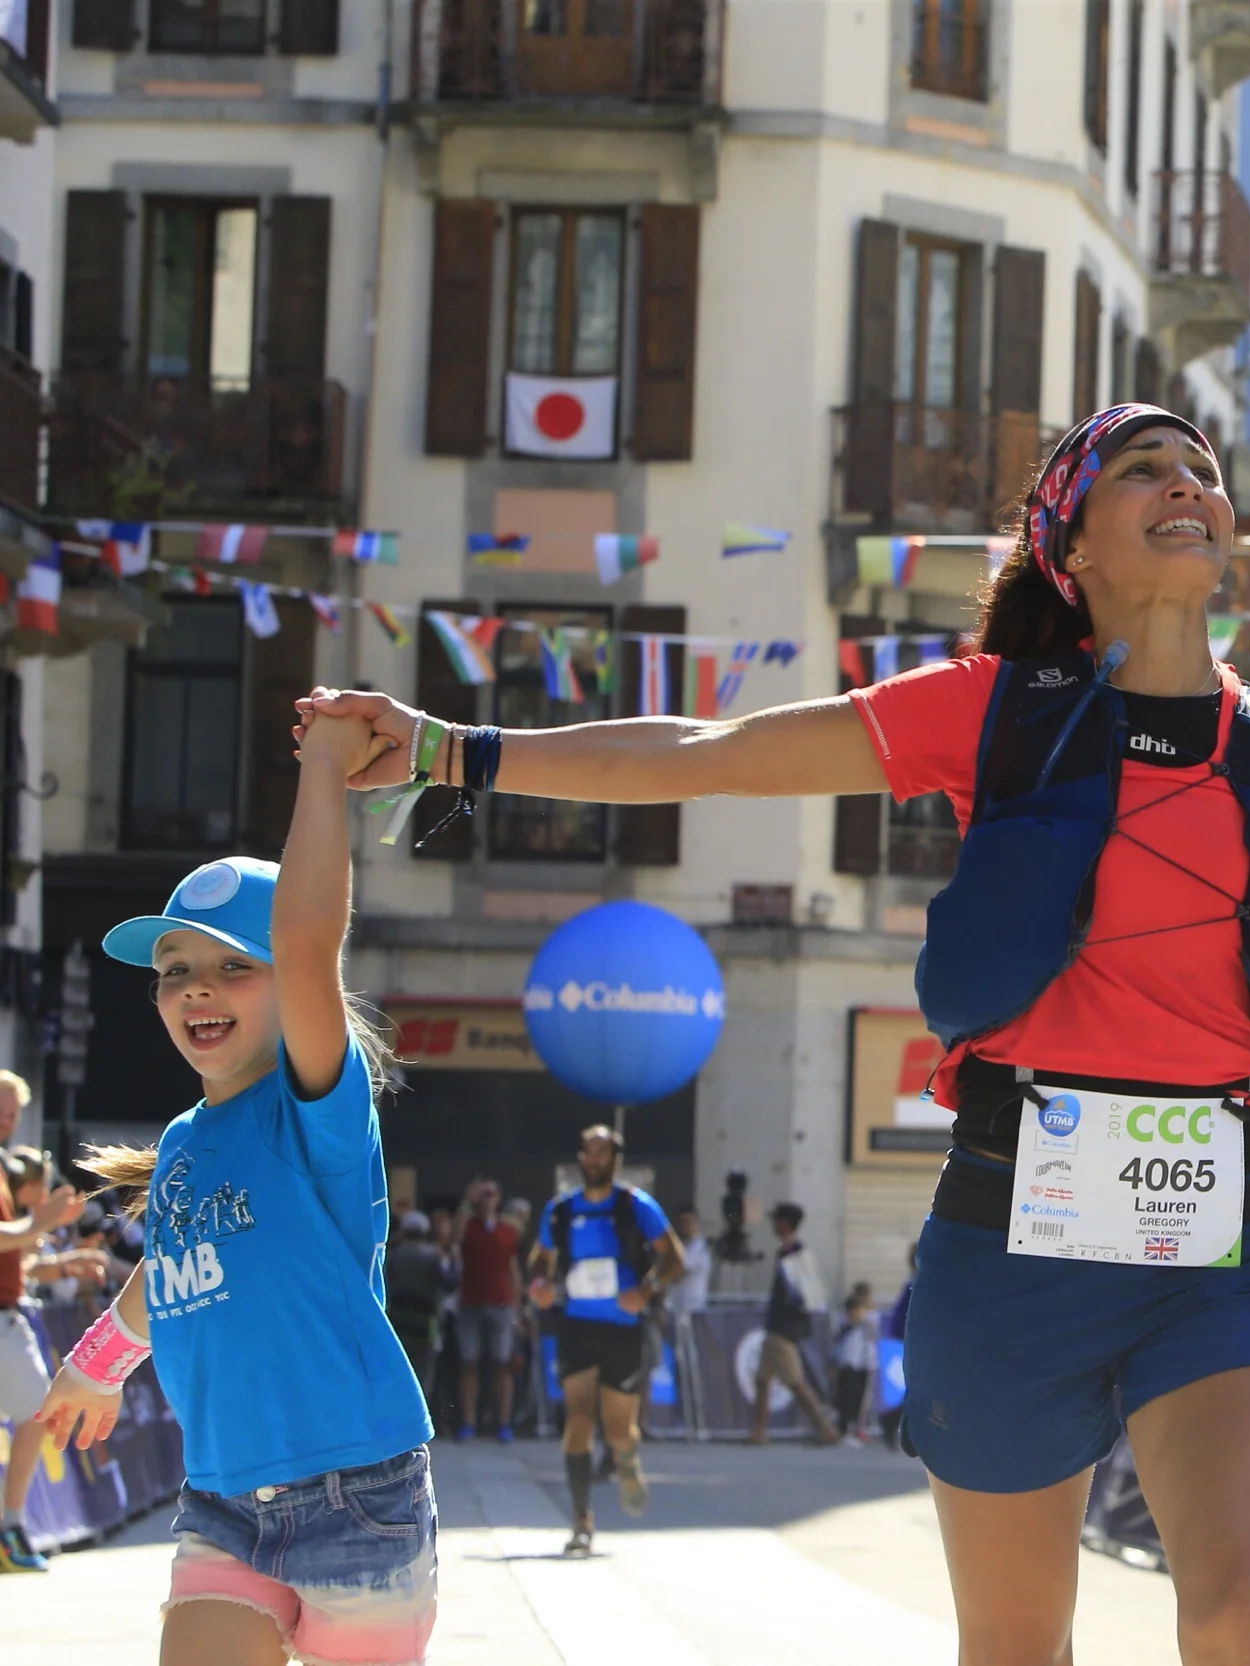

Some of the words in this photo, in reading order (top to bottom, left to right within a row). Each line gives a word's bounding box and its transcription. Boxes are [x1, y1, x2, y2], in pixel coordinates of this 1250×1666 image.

[1129, 733, 1176, 755] dhb
[582, 981, 697, 1016] Columbia
[1044, 1114, 1074, 1126] UTMB
[1107, 1102, 1122, 1140] 2019
[1126, 1104, 1212, 1144] CCC
[1118, 1157, 1216, 1193] 4065
[1032, 1204, 1079, 1218] Columbia
[1134, 1197, 1197, 1214] Lauren
[1139, 1217, 1190, 1227] GREGORY
[144, 1242, 224, 1307] TMB
